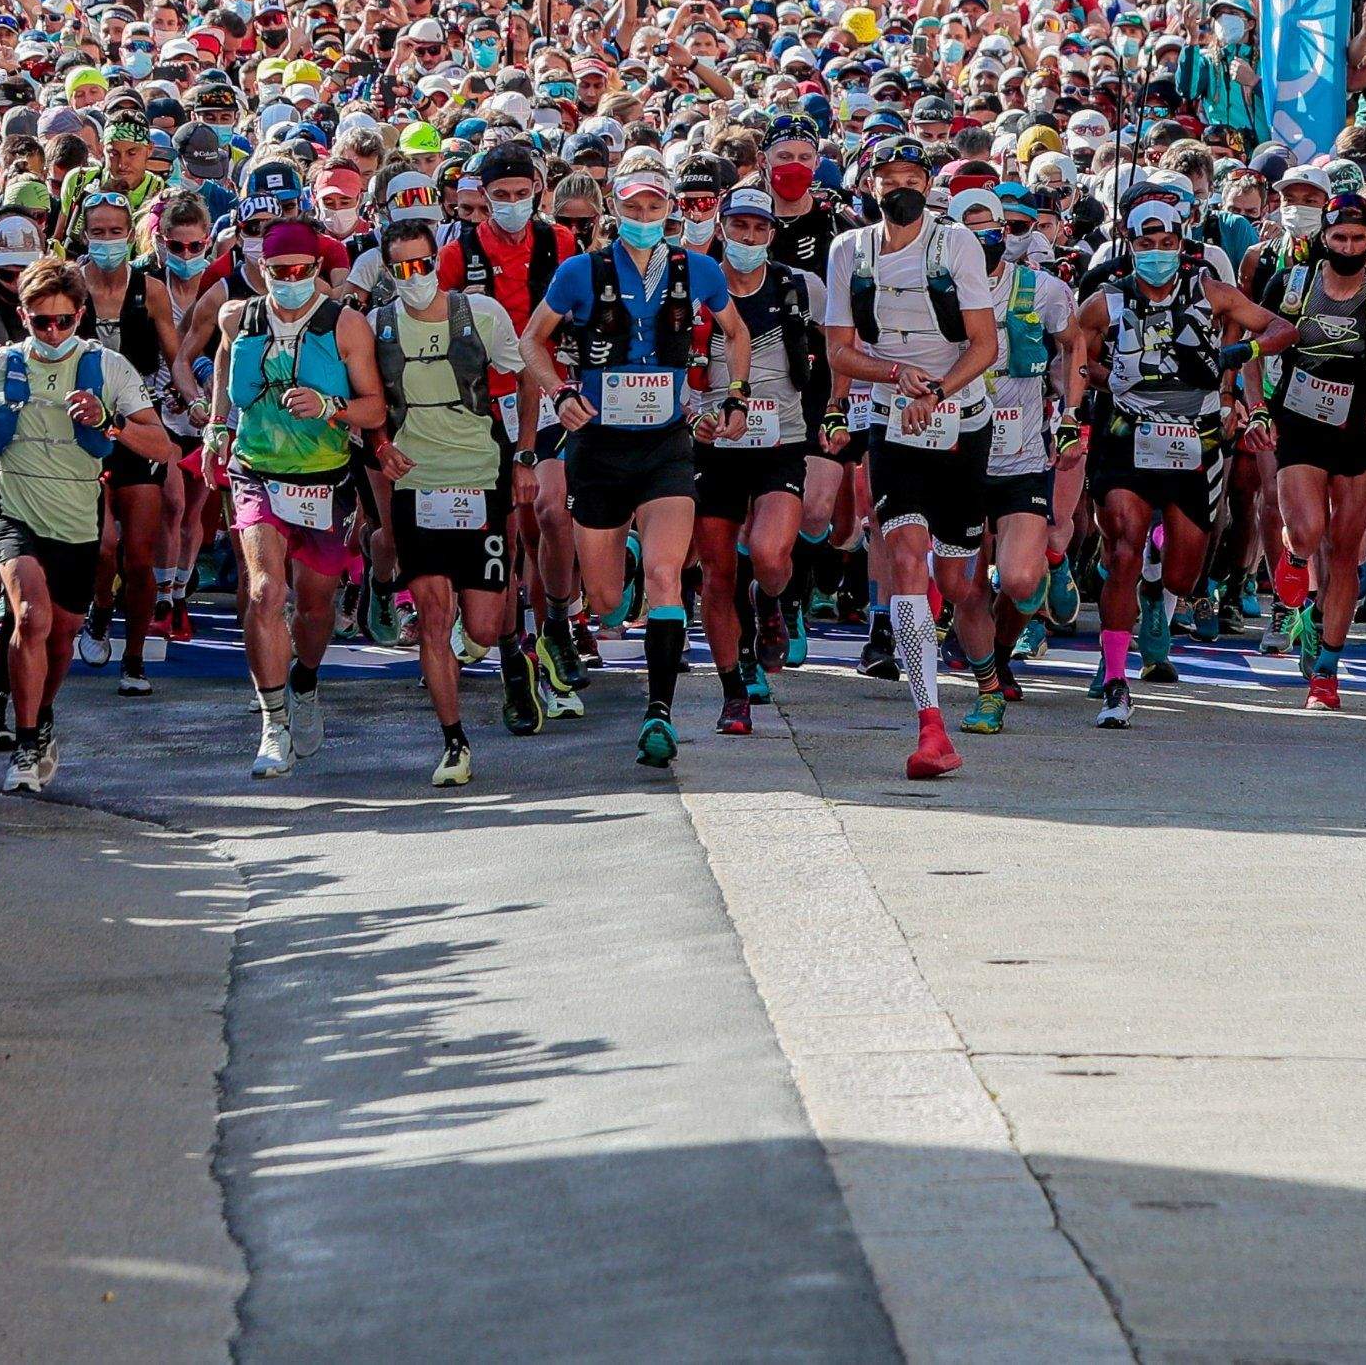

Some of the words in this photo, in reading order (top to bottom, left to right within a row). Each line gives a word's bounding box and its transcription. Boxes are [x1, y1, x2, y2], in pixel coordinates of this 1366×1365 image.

[682, 174, 714, 183] TERREX
[626, 376, 669, 388] UTMB
[1310, 379, 1350, 397] UTMB
[640, 391, 656, 402] 35
[1320, 395, 1335, 407] 19
[746, 400, 776, 411] TMB
[853, 405, 868, 415] 85
[748, 415, 763, 426] 59
[1156, 424, 1198, 438] UTMB
[1169, 441, 1185, 451] 42
[286, 485, 329, 500] UTMB
[299, 502, 315, 512] 45
[453, 496, 469, 508] 24
